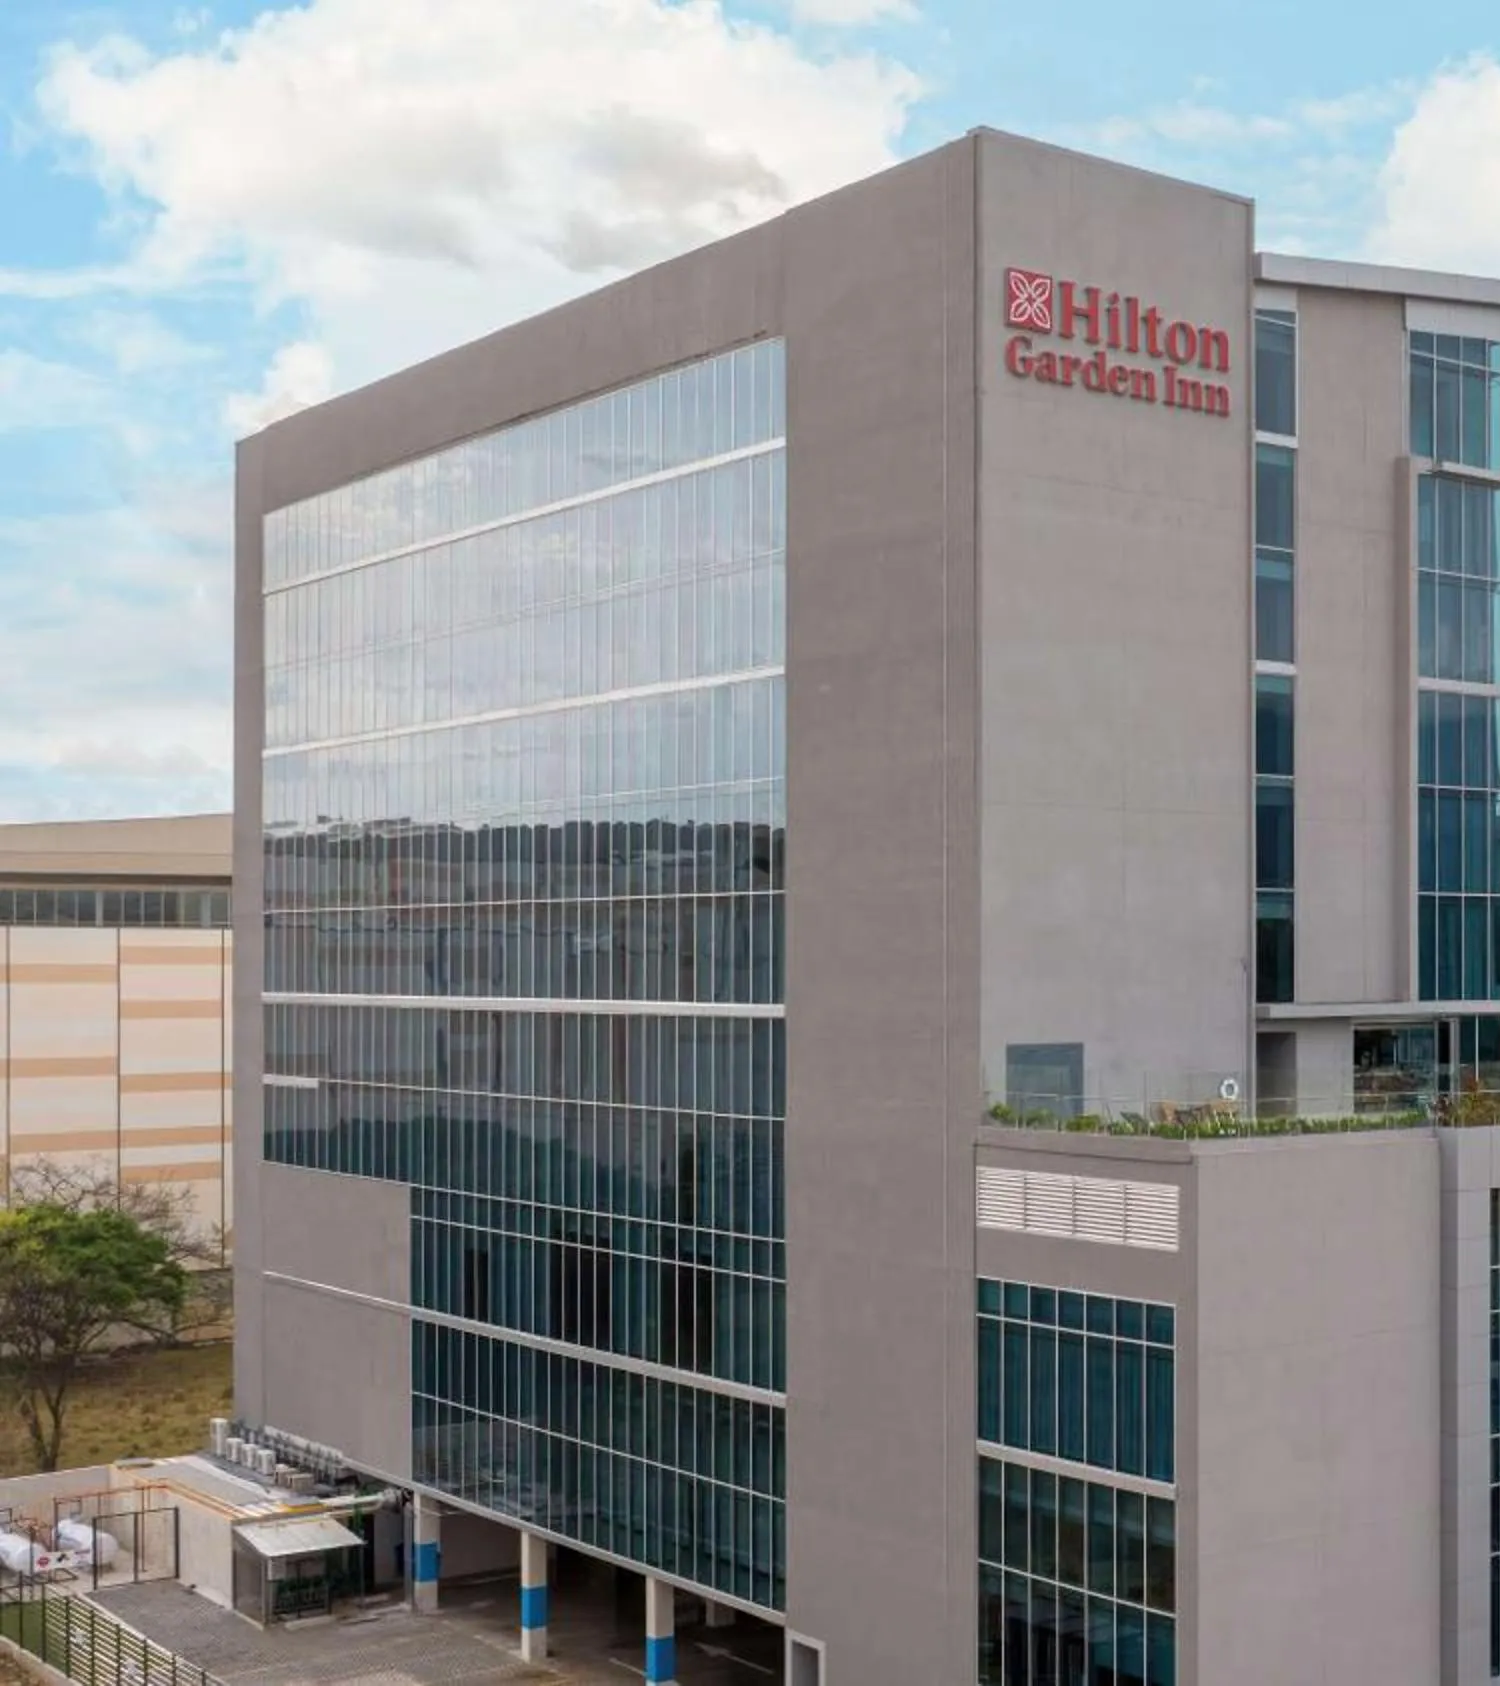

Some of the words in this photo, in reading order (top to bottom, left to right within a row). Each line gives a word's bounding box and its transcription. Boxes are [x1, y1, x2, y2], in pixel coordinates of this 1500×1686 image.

[1058, 280, 1229, 374] Hilton
[1004, 335, 1157, 404] Garden
[1163, 365, 1230, 418] Inn
